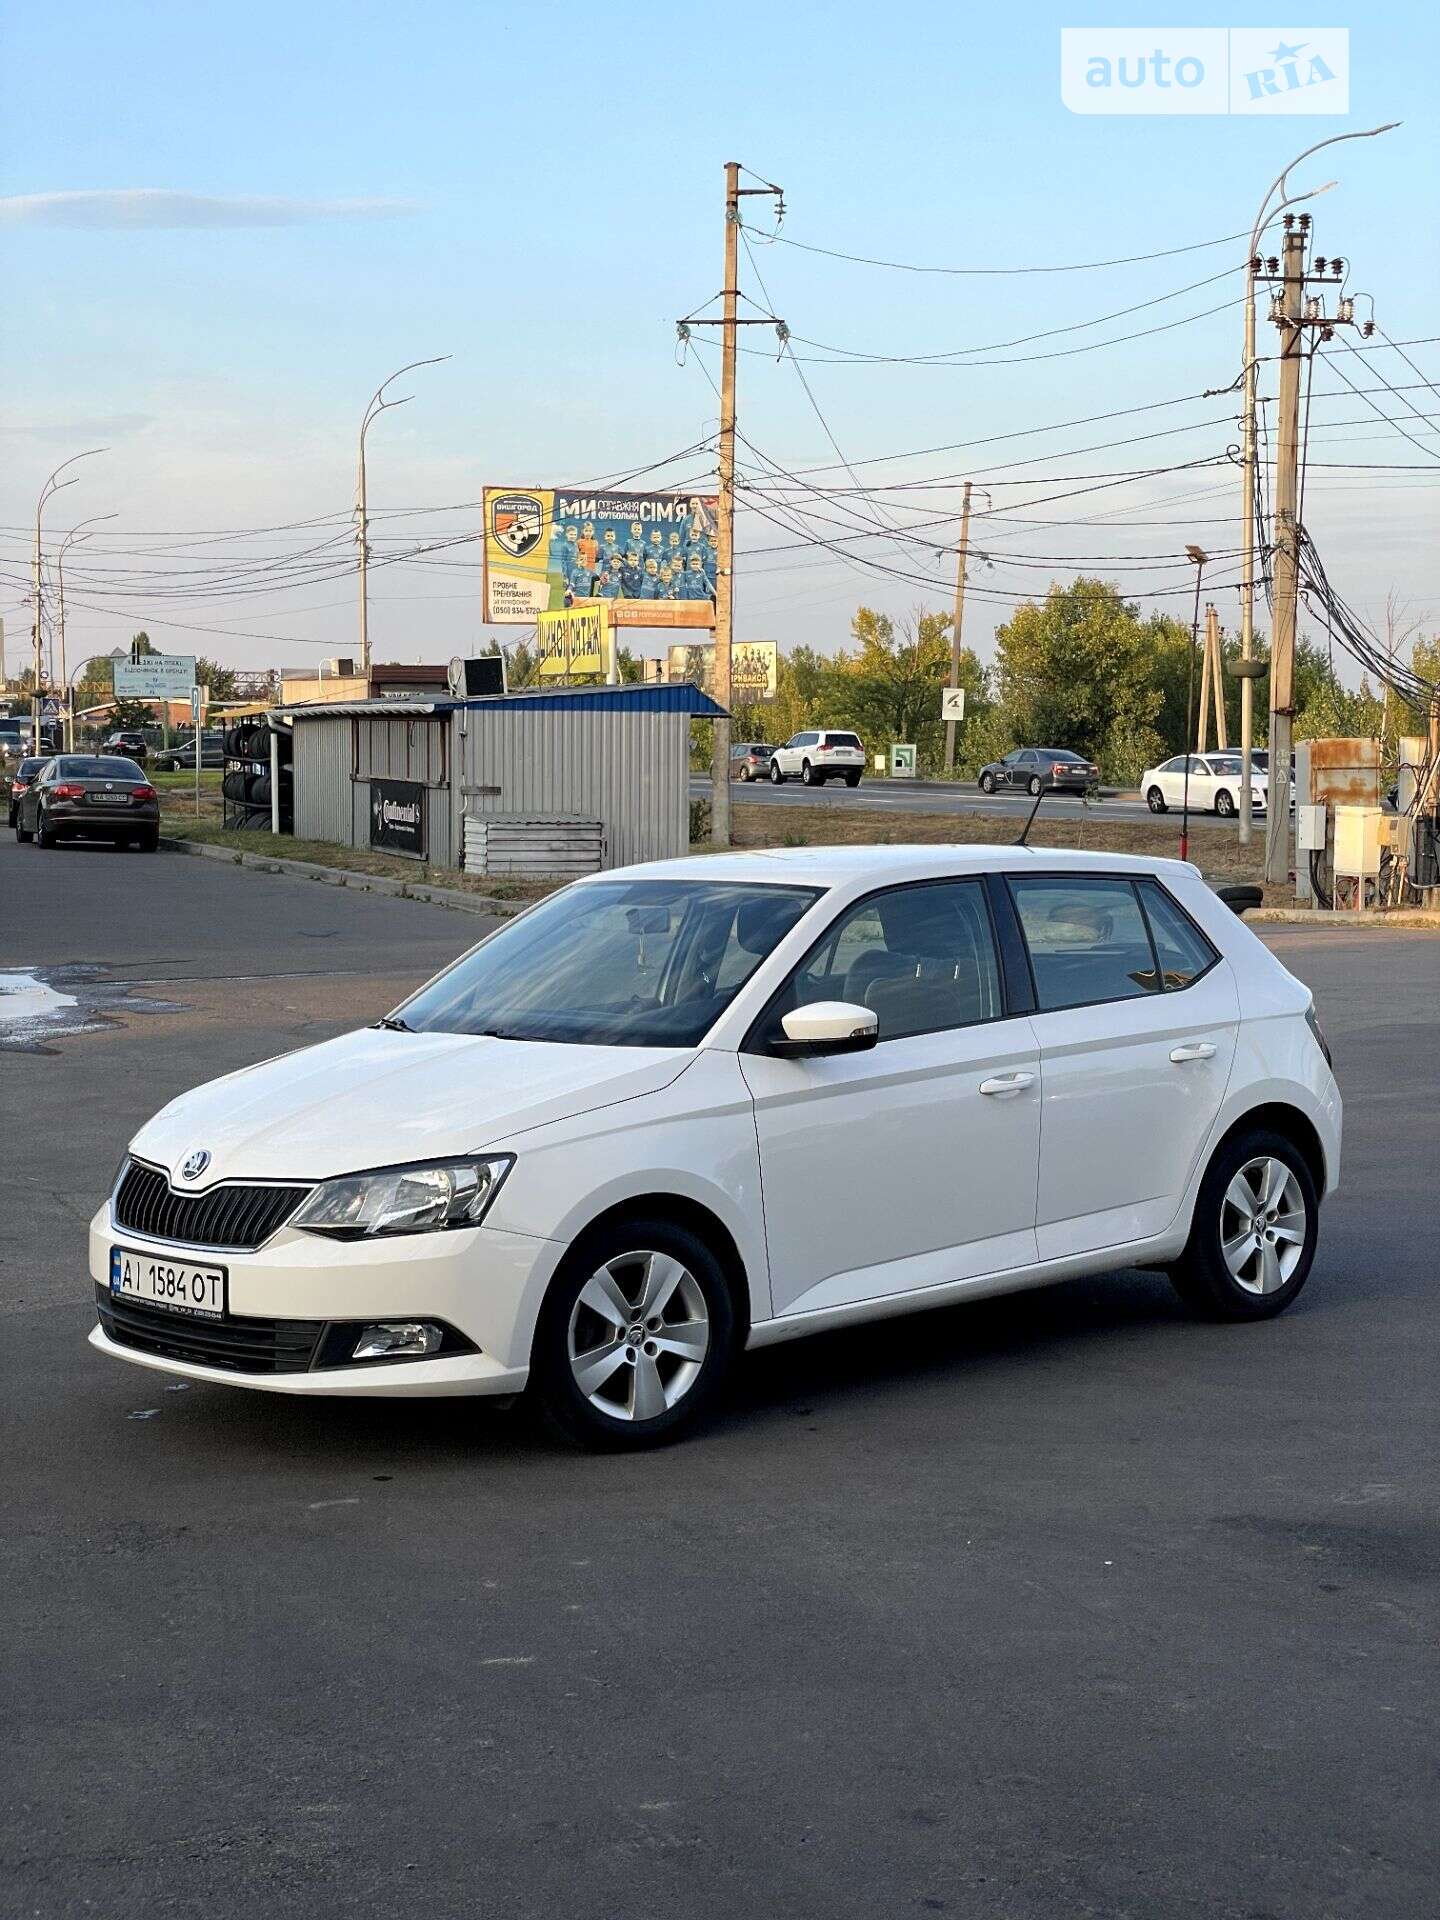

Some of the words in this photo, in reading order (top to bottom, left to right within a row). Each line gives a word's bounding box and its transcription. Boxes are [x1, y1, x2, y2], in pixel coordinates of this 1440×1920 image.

[496, 504, 538, 512] ВИШГОРОД
[560, 498, 596, 520] МИ
[598, 511, 639, 520] ФУТБОЛЬНА
[492, 581, 518, 590] ПРОБНЕ
[493, 590, 533, 598] ТРЕНУВАННЯ
[122, 1259, 140, 1291] AI
[149, 1264, 187, 1300] 1584
[192, 1273, 220, 1305] OT
